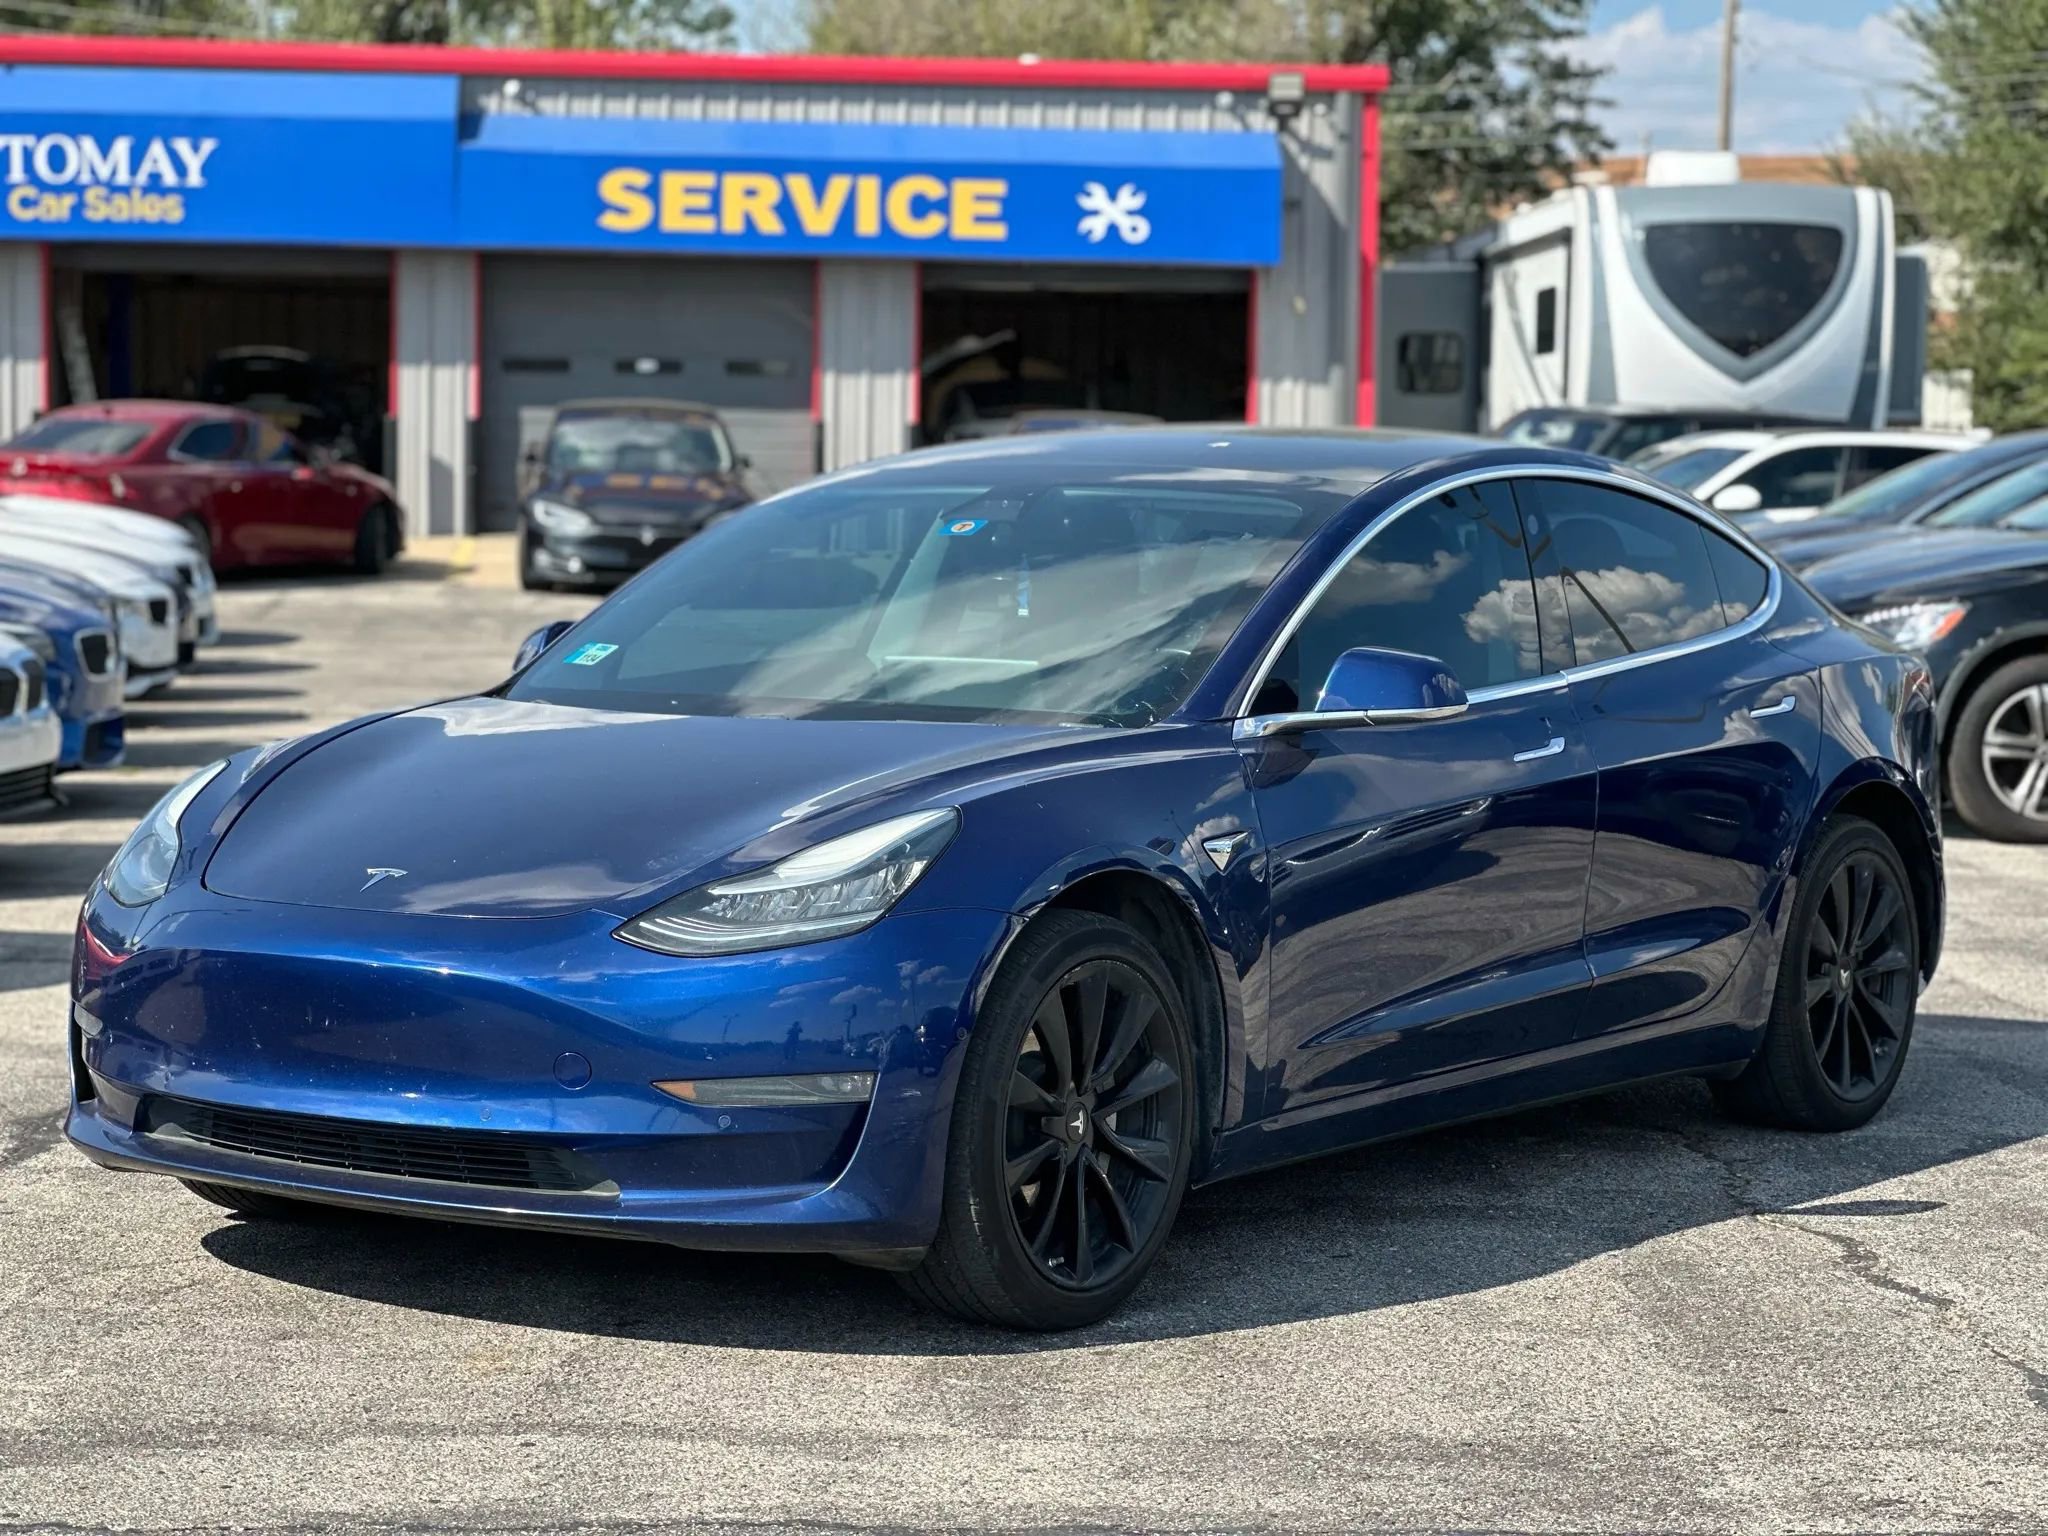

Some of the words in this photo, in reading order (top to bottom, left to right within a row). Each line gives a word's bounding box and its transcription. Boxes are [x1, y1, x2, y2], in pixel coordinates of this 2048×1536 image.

[0, 133, 219, 188] TOMAY
[8, 185, 78, 222] Car
[82, 185, 185, 224] Sales
[597, 167, 1009, 241] SERVICE
